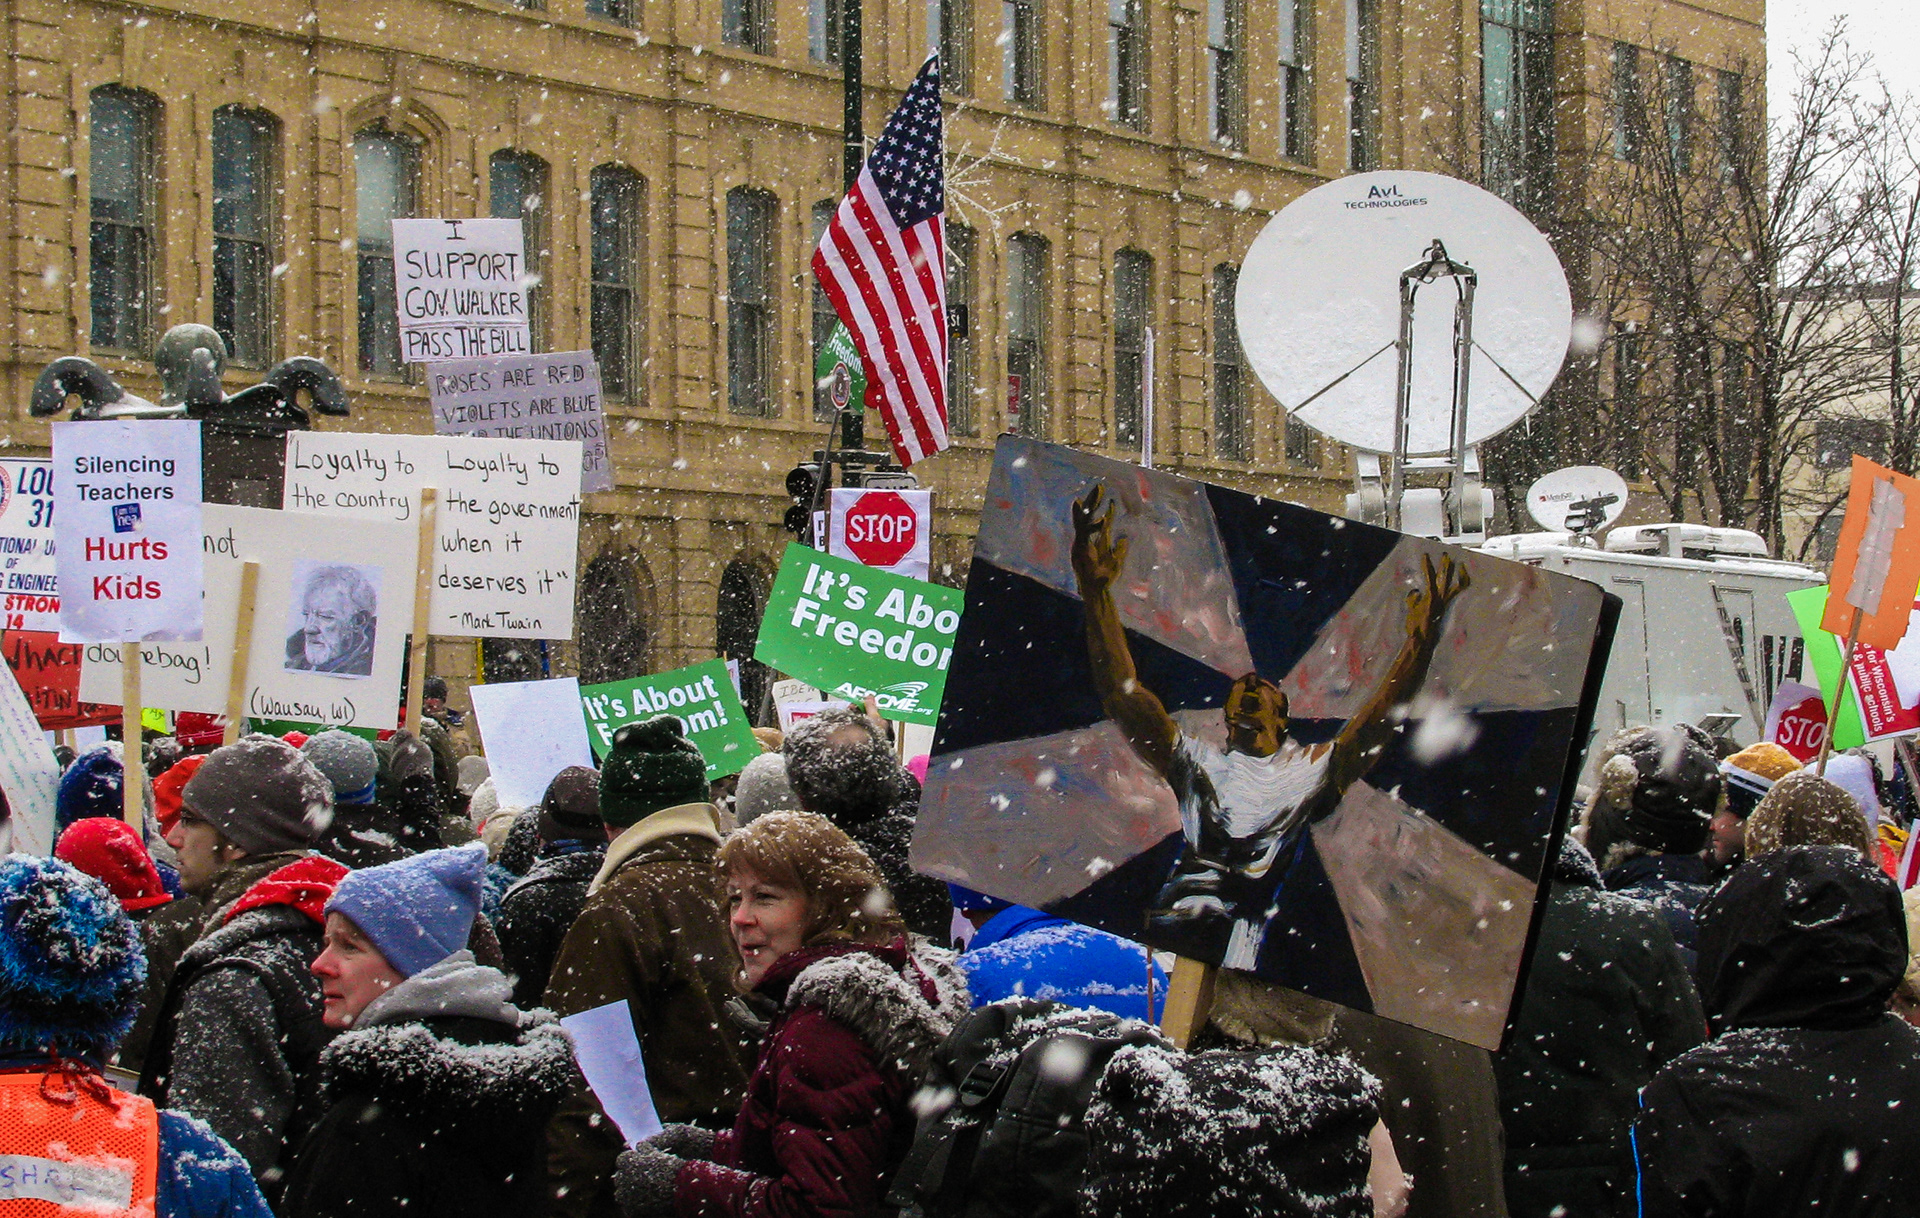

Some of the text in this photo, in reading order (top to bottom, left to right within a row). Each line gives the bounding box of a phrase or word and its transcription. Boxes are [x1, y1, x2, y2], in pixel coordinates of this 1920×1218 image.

[1344, 198, 1428, 209] TECHNOLOGIES
[444, 219, 466, 241] I
[405, 249, 519, 282] SUPPORT
[404, 286, 523, 319] GOV. WALKER
[405, 326, 526, 357] PASS THE BILL
[435, 364, 585, 396] ROSES ARE RED
[441, 394, 597, 424] VIOLETS ARE BLUE
[75, 455, 175, 476] Silencing
[394, 451, 415, 474] to
[446, 449, 560, 485] Loyalty to
[76, 484, 175, 501] Teachers
[292, 484, 410, 521] the country
[446, 489, 580, 524] the government
[441, 529, 522, 553] when it
[849, 514, 913, 543] STOP
[6, 558, 19, 569] OF
[85, 537, 169, 562] Hurts
[92, 575, 162, 601] Kids
[438, 565, 527, 594] deserves
[802, 563, 868, 611] It's
[495, 611, 543, 630] Twain
[1866, 650, 1878, 664] for
[583, 694, 627, 720] It's
[633, 675, 719, 715] About
[1854, 662, 1872, 692] public
[1864, 694, 1884, 732] schools
[1871, 665, 1896, 723] Wisconsin's
